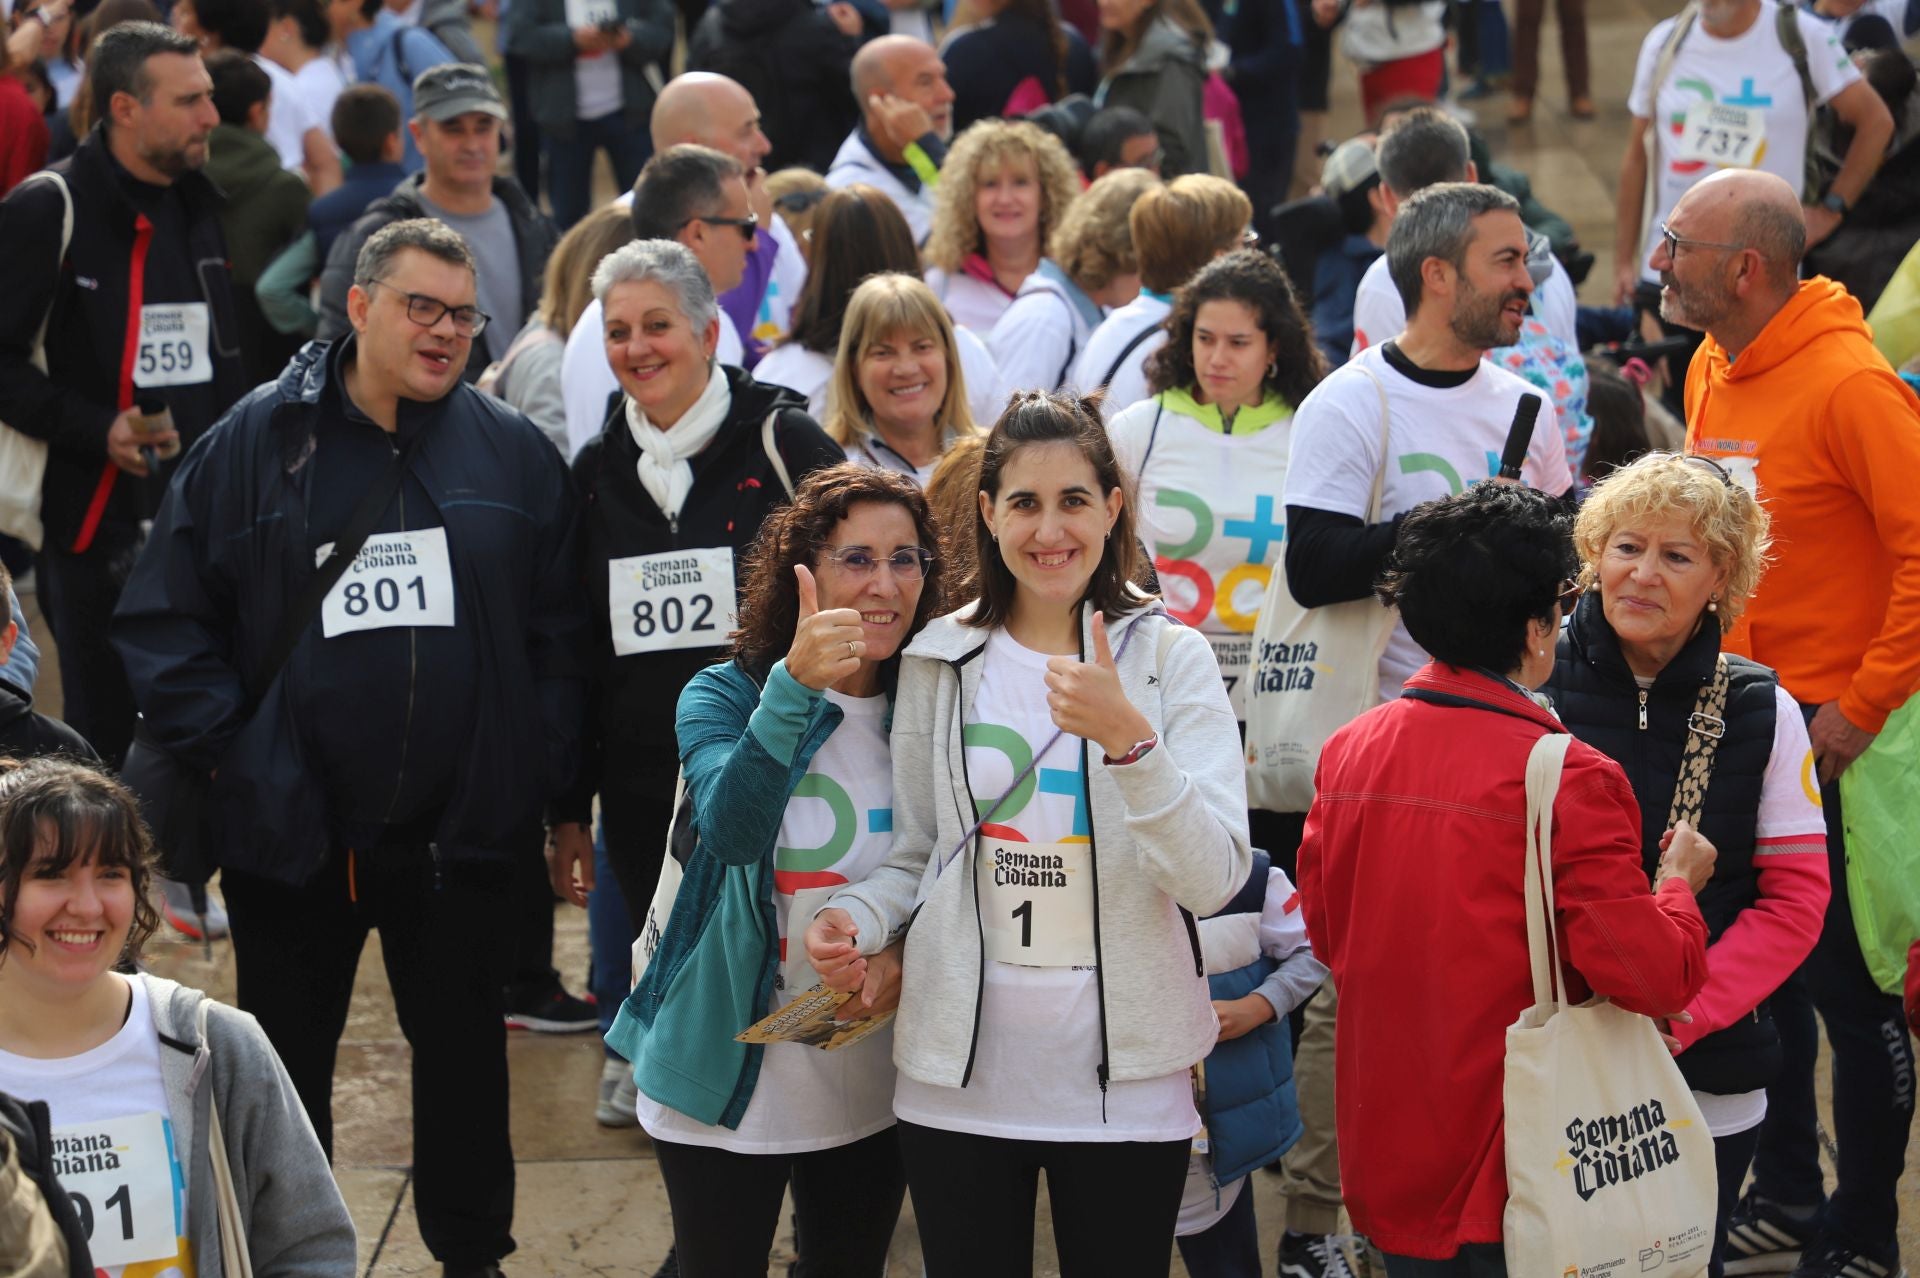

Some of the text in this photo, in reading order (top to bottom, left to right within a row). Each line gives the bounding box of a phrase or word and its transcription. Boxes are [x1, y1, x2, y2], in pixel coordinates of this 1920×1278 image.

[1696, 127, 1750, 157] 737
[140, 341, 193, 373] 559
[361, 542, 412, 556] emana
[642, 557, 698, 575] Semana
[642, 569, 702, 591] Cidiana
[343, 575, 427, 616] 801
[633, 593, 715, 637] 802
[994, 847, 1063, 869] Semana
[994, 865, 1067, 888] Cidiana
[1011, 900, 1032, 947] 1
[1573, 1130, 1680, 1202] Cidiana
[1580, 1257, 1626, 1276] Ayuntamiento
